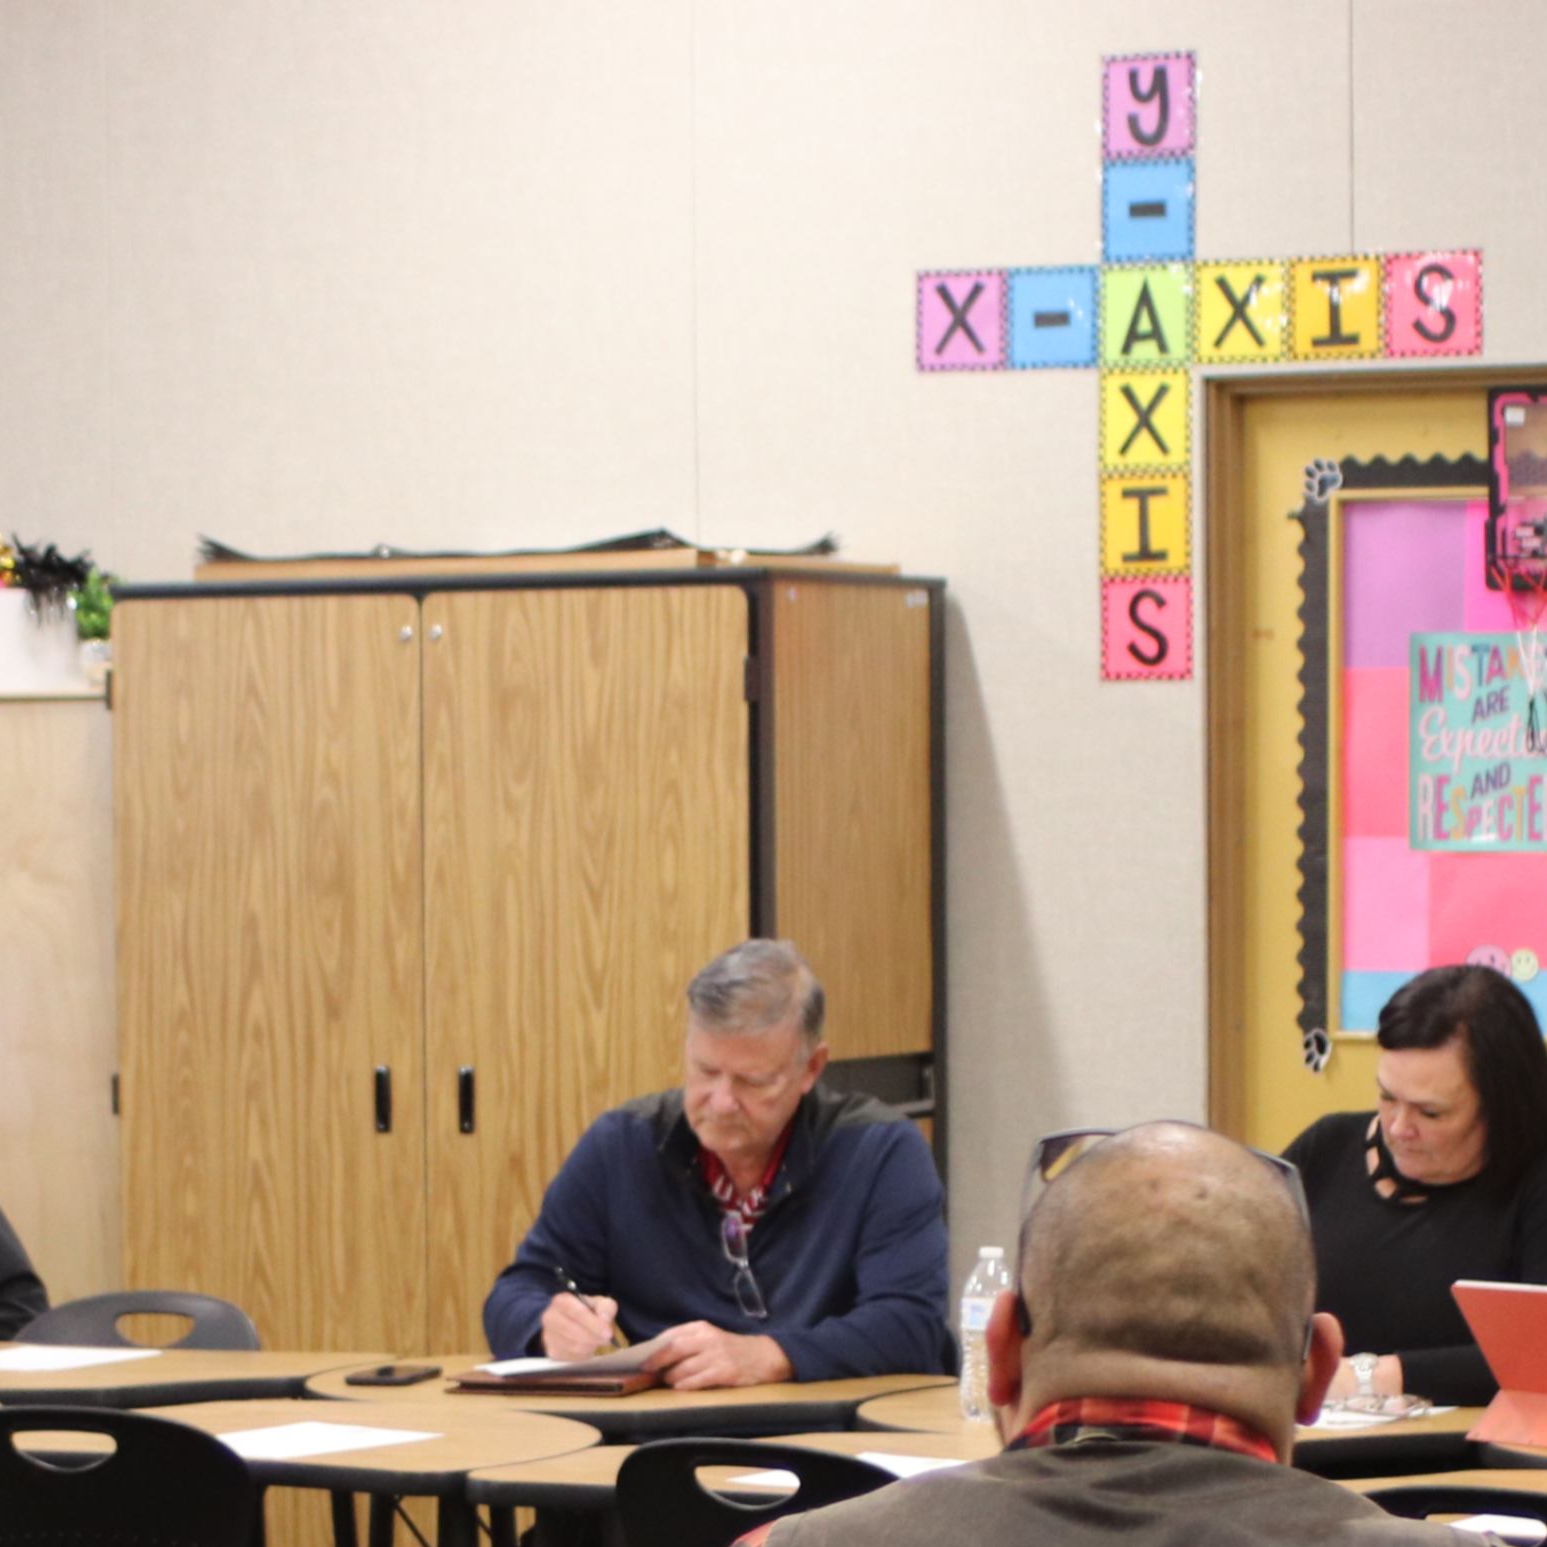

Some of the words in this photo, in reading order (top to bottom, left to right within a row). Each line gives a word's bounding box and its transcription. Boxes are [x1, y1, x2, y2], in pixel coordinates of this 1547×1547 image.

[935, 262, 1457, 355] X-AXIS
[1471, 686, 1511, 724] ARE
[1471, 761, 1513, 801] AND
